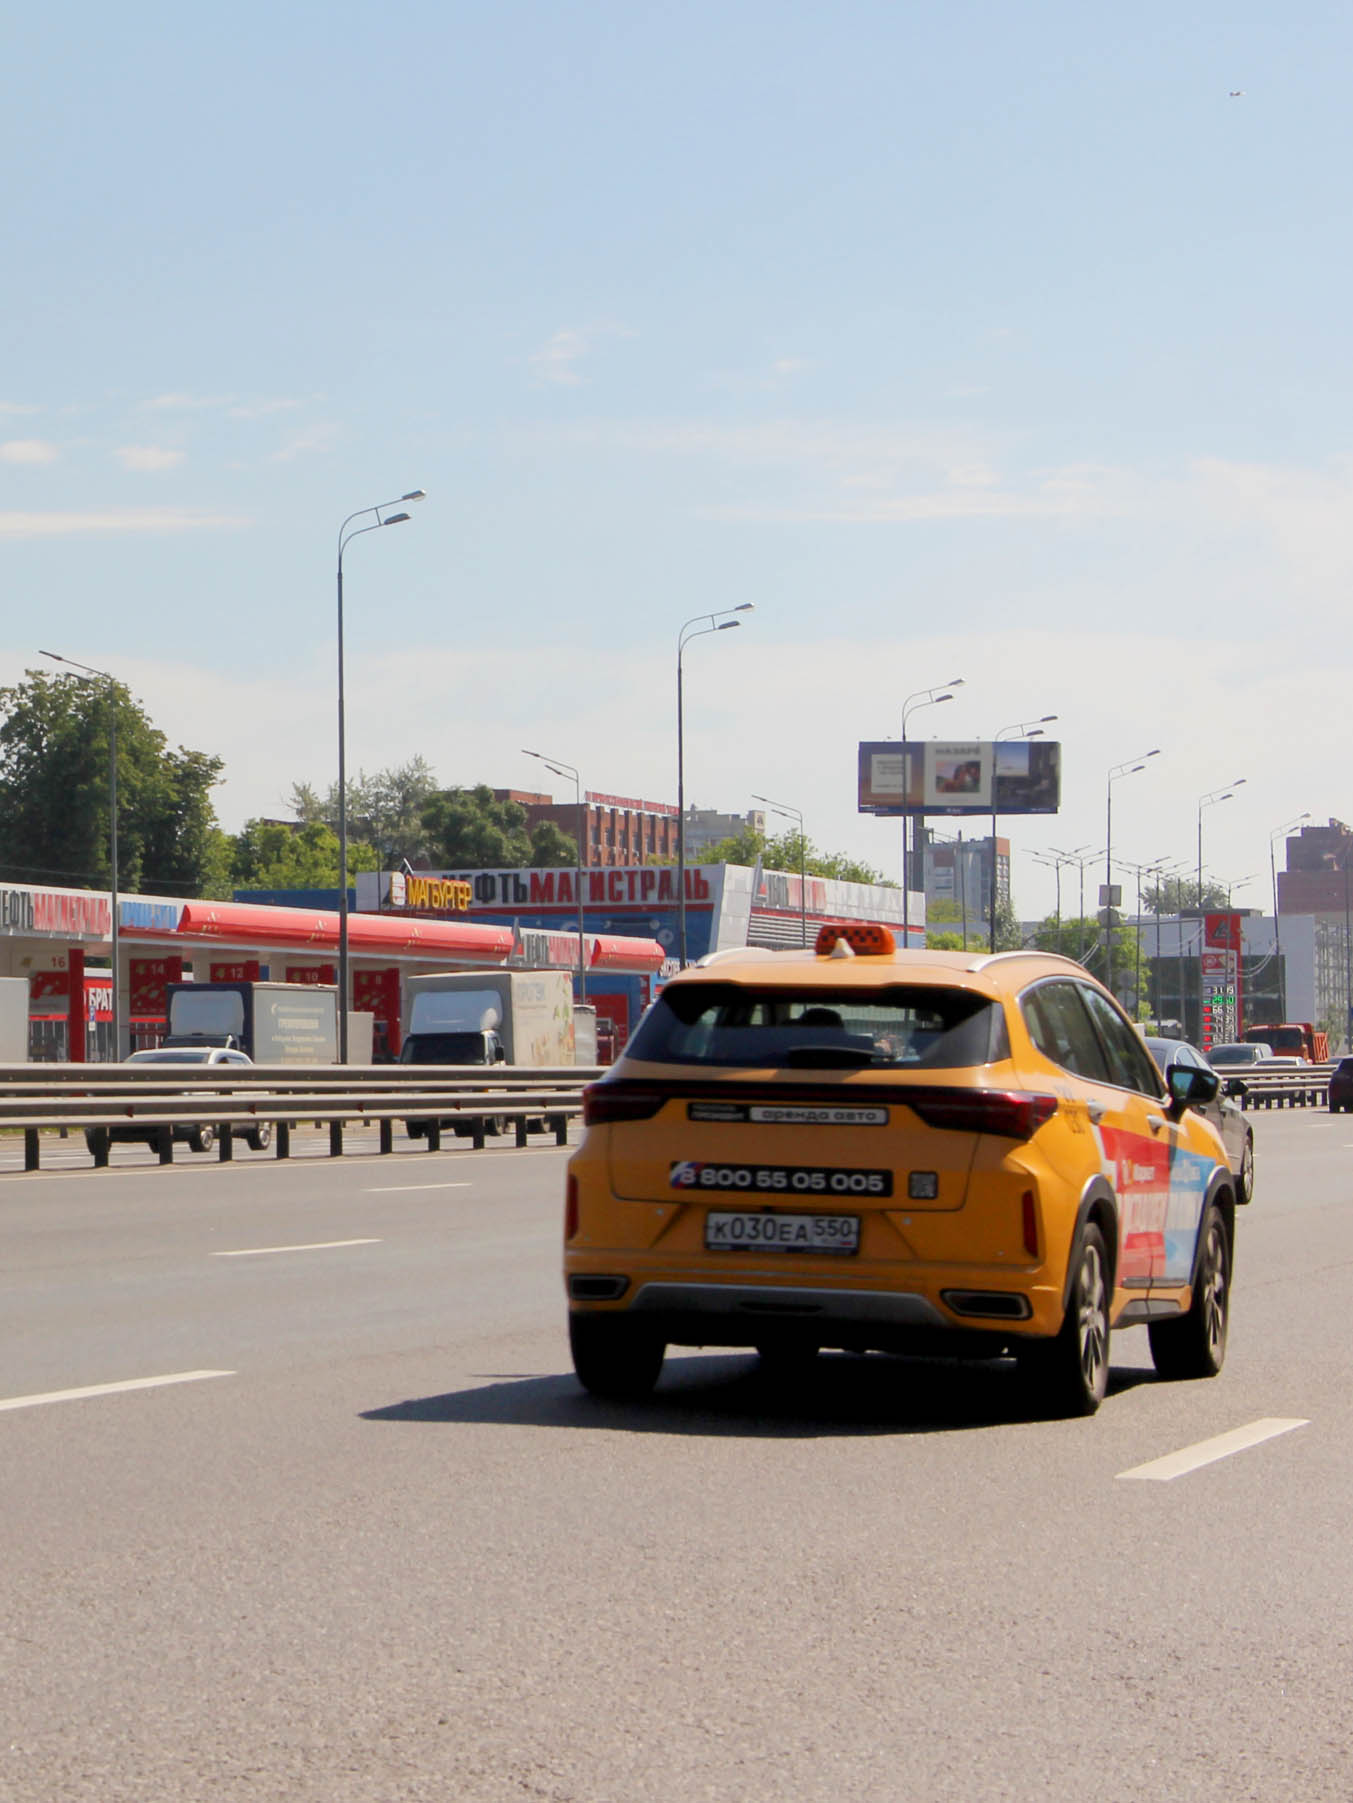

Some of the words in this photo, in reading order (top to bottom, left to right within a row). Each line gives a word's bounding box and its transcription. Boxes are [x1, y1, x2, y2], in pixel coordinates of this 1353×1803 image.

[51, 956, 66, 968] 16
[151, 963, 165, 975] 14
[761, 1109, 829, 1122] аренда
[834, 1111, 878, 1121] авто
[679, 1169, 696, 1184] 8
[700, 1169, 752, 1186] 800
[756, 1171, 787, 1188] 55
[792, 1172, 826, 1190] 05
[831, 1174, 884, 1191] 005
